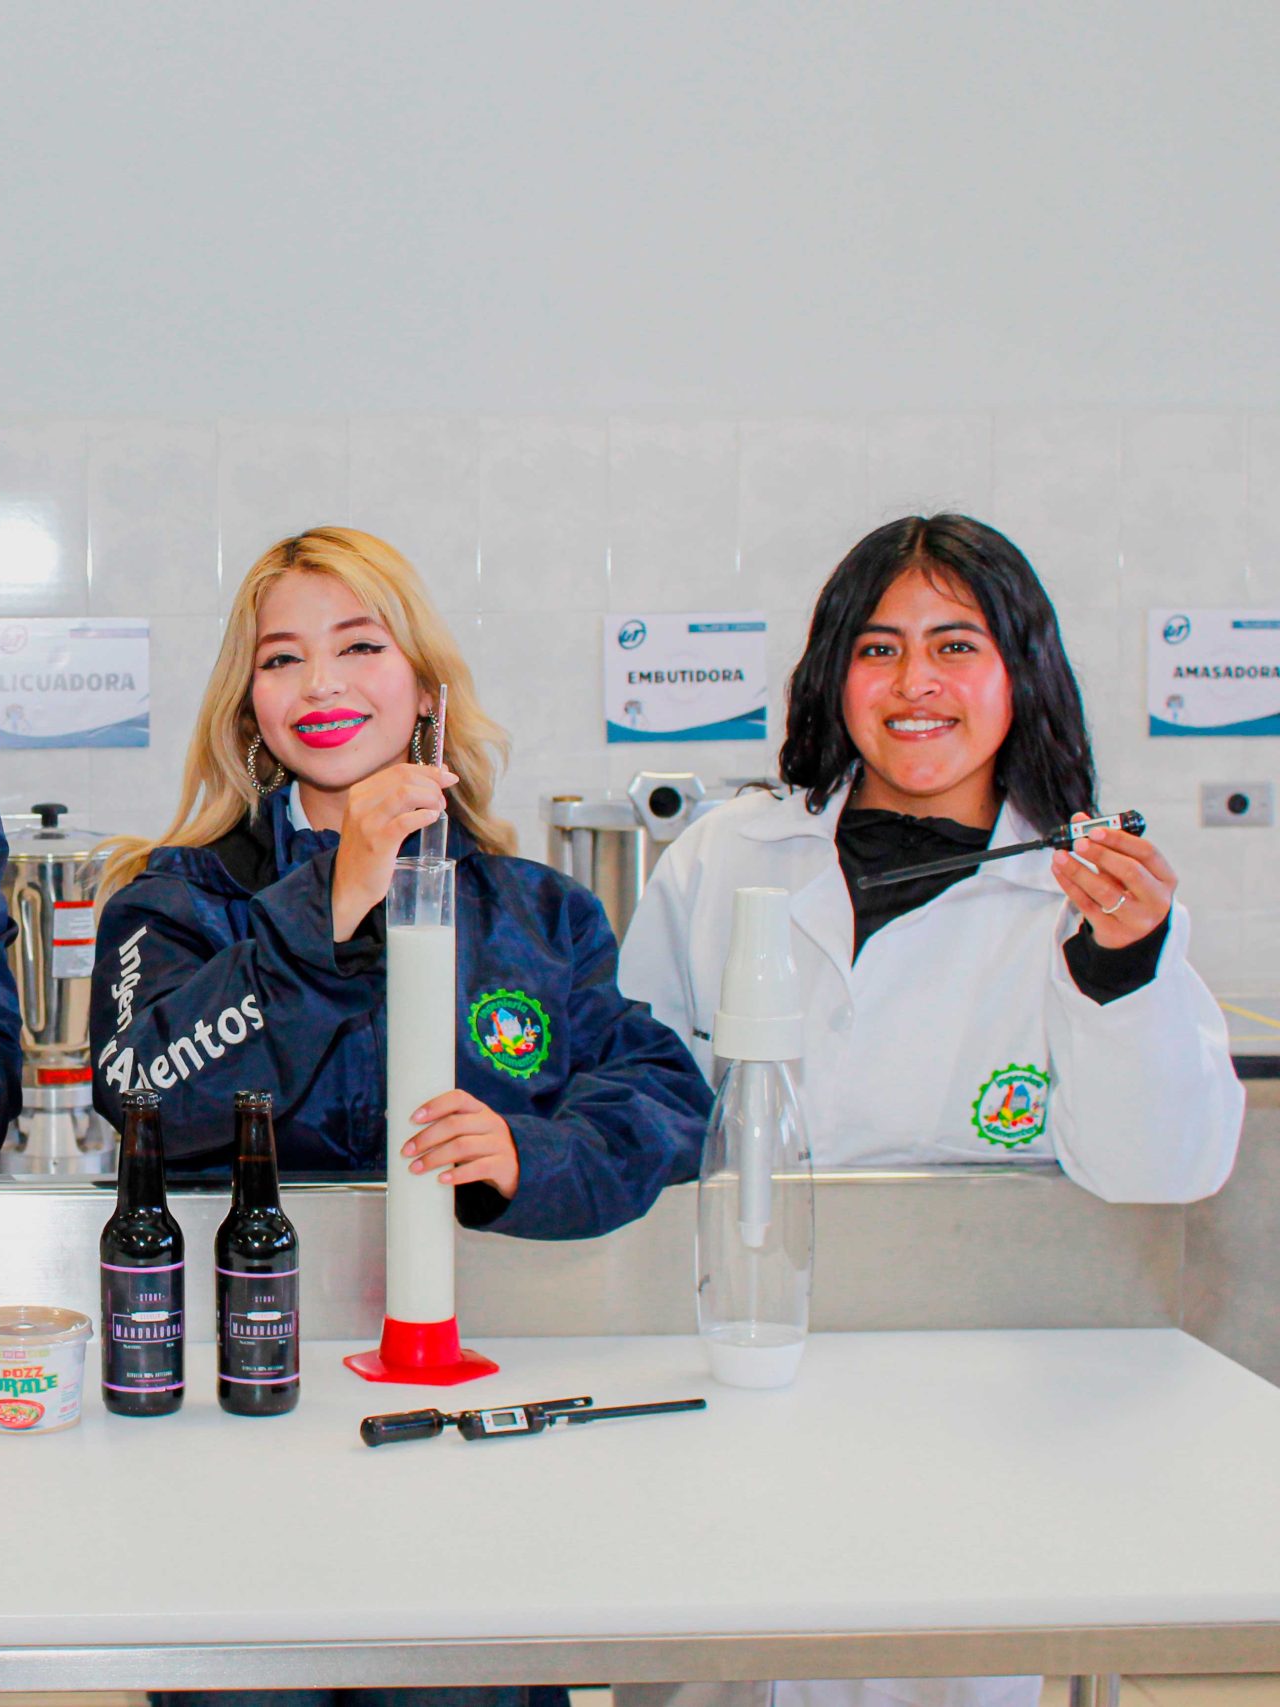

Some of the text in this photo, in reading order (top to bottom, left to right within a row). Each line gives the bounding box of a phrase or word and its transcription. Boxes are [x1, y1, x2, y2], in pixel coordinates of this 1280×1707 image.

[627, 669, 745, 685] EMBUTIDORA
[1173, 666, 1280, 679] AMASADORA
[2, 1366, 44, 1378] POZZ
